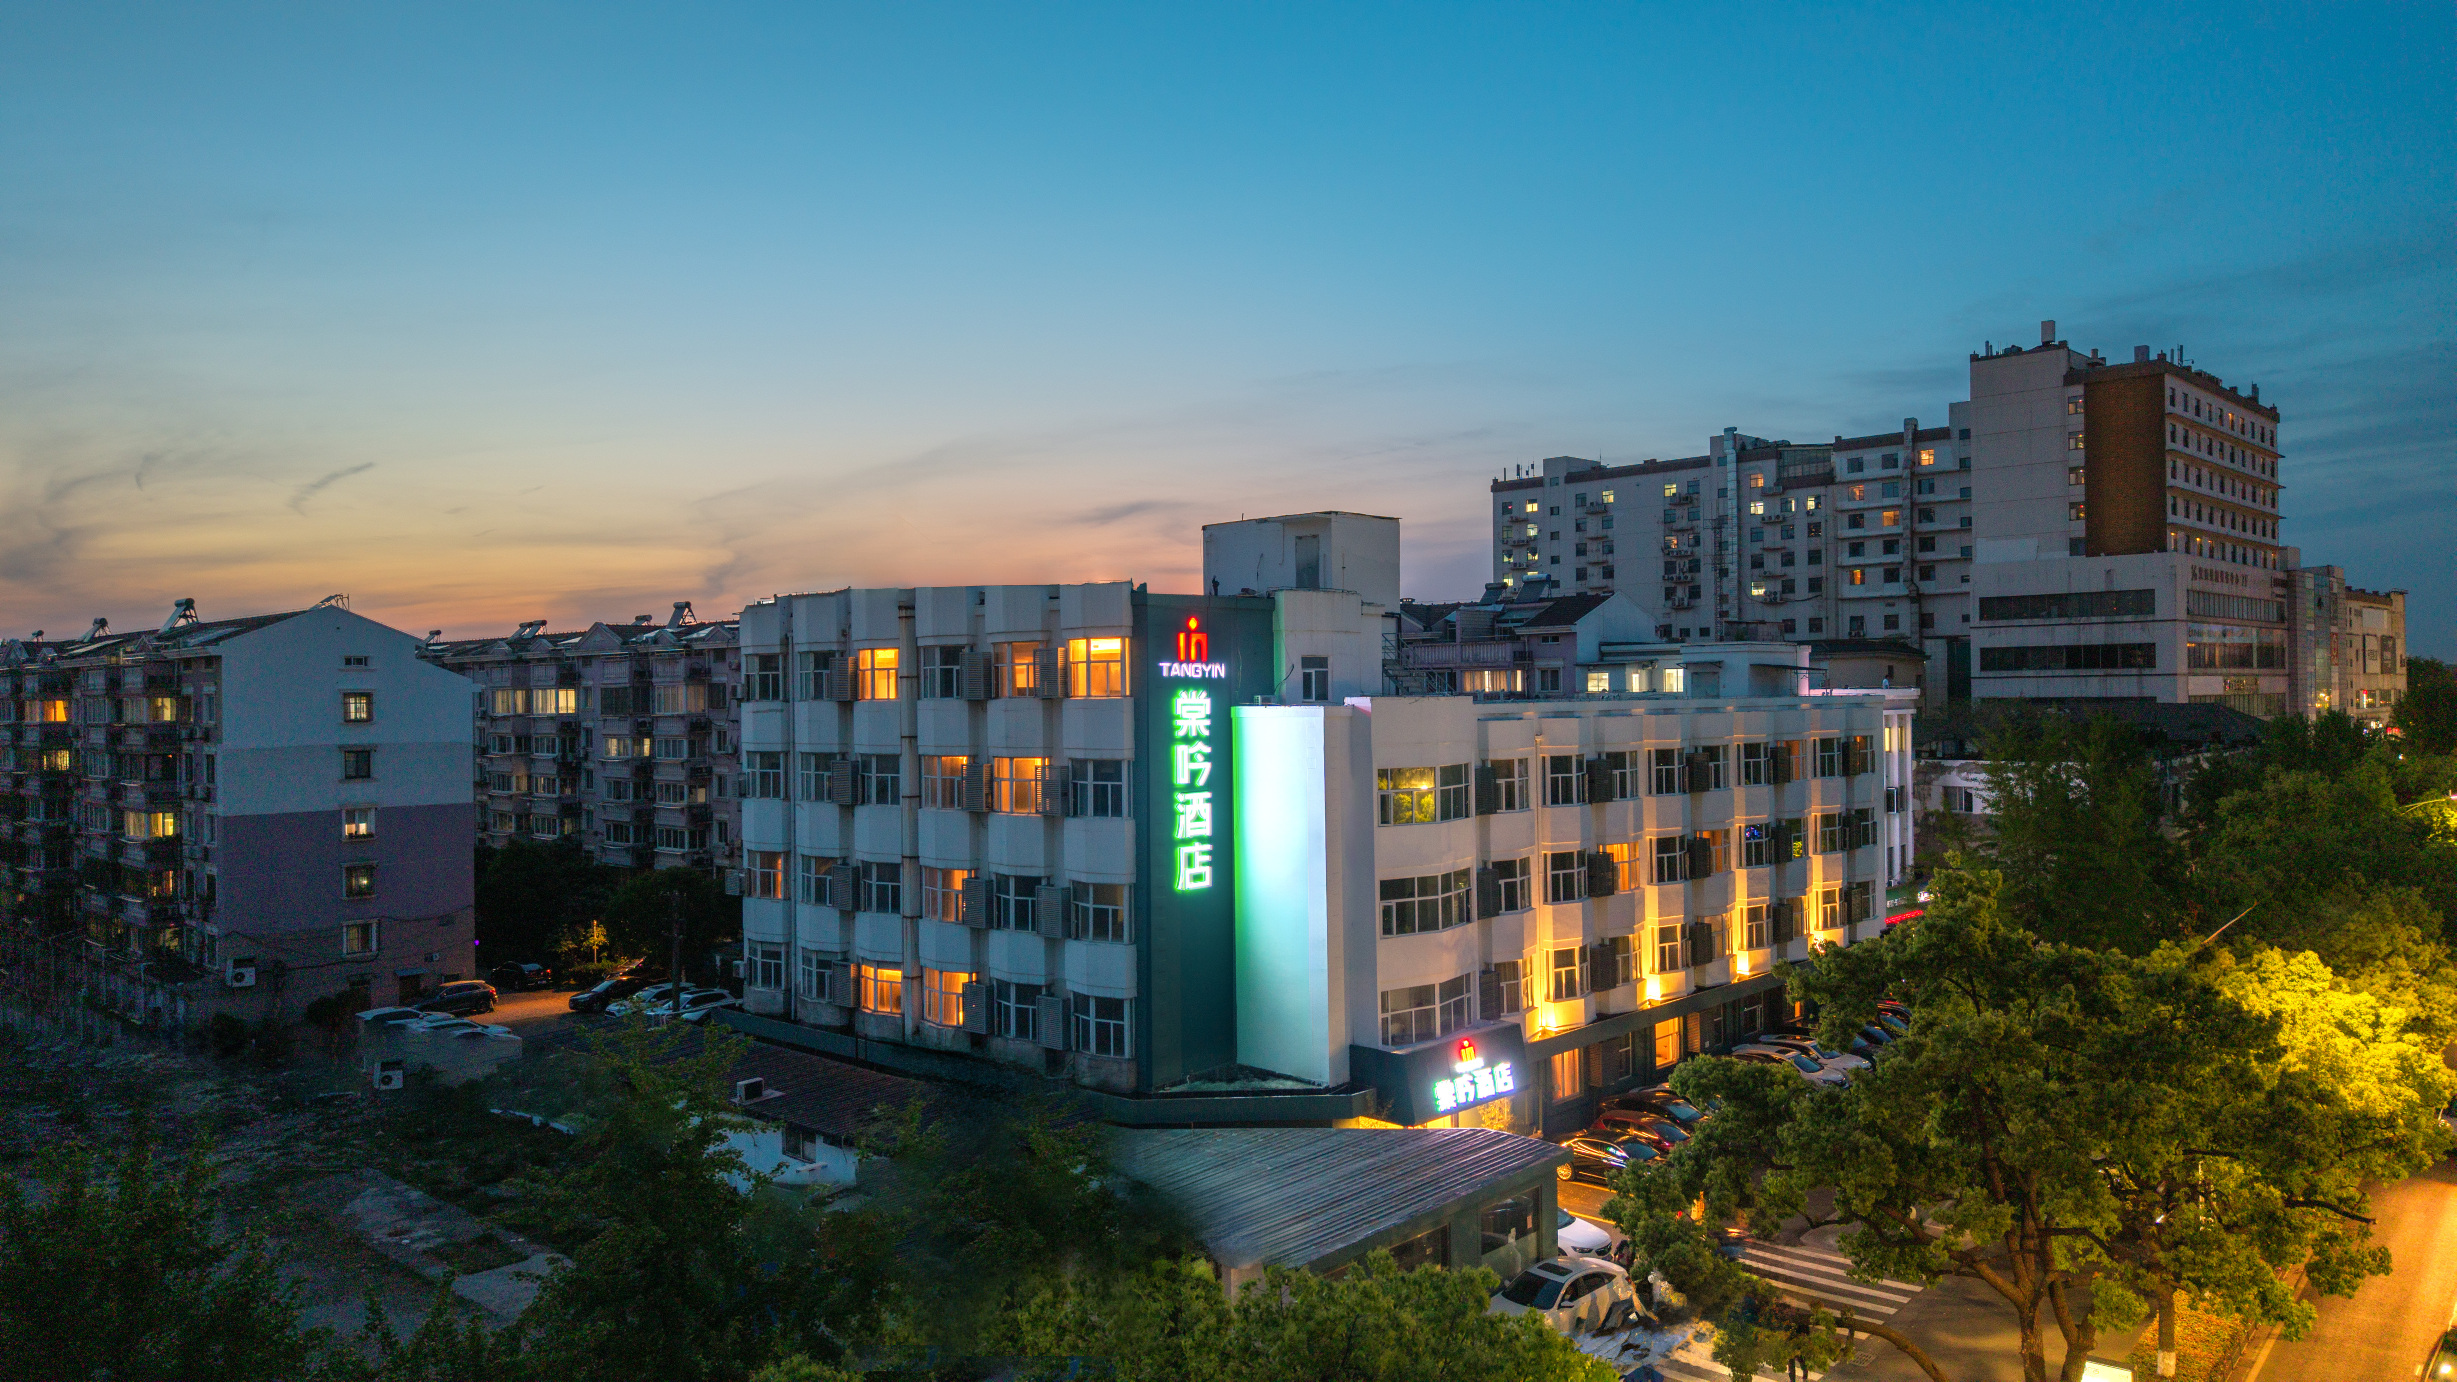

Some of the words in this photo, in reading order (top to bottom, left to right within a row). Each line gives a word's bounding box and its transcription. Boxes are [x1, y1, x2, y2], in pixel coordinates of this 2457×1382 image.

[1158, 662, 1226, 679] TANGYIN
[1174, 690, 1213, 891] 棠吟酒店
